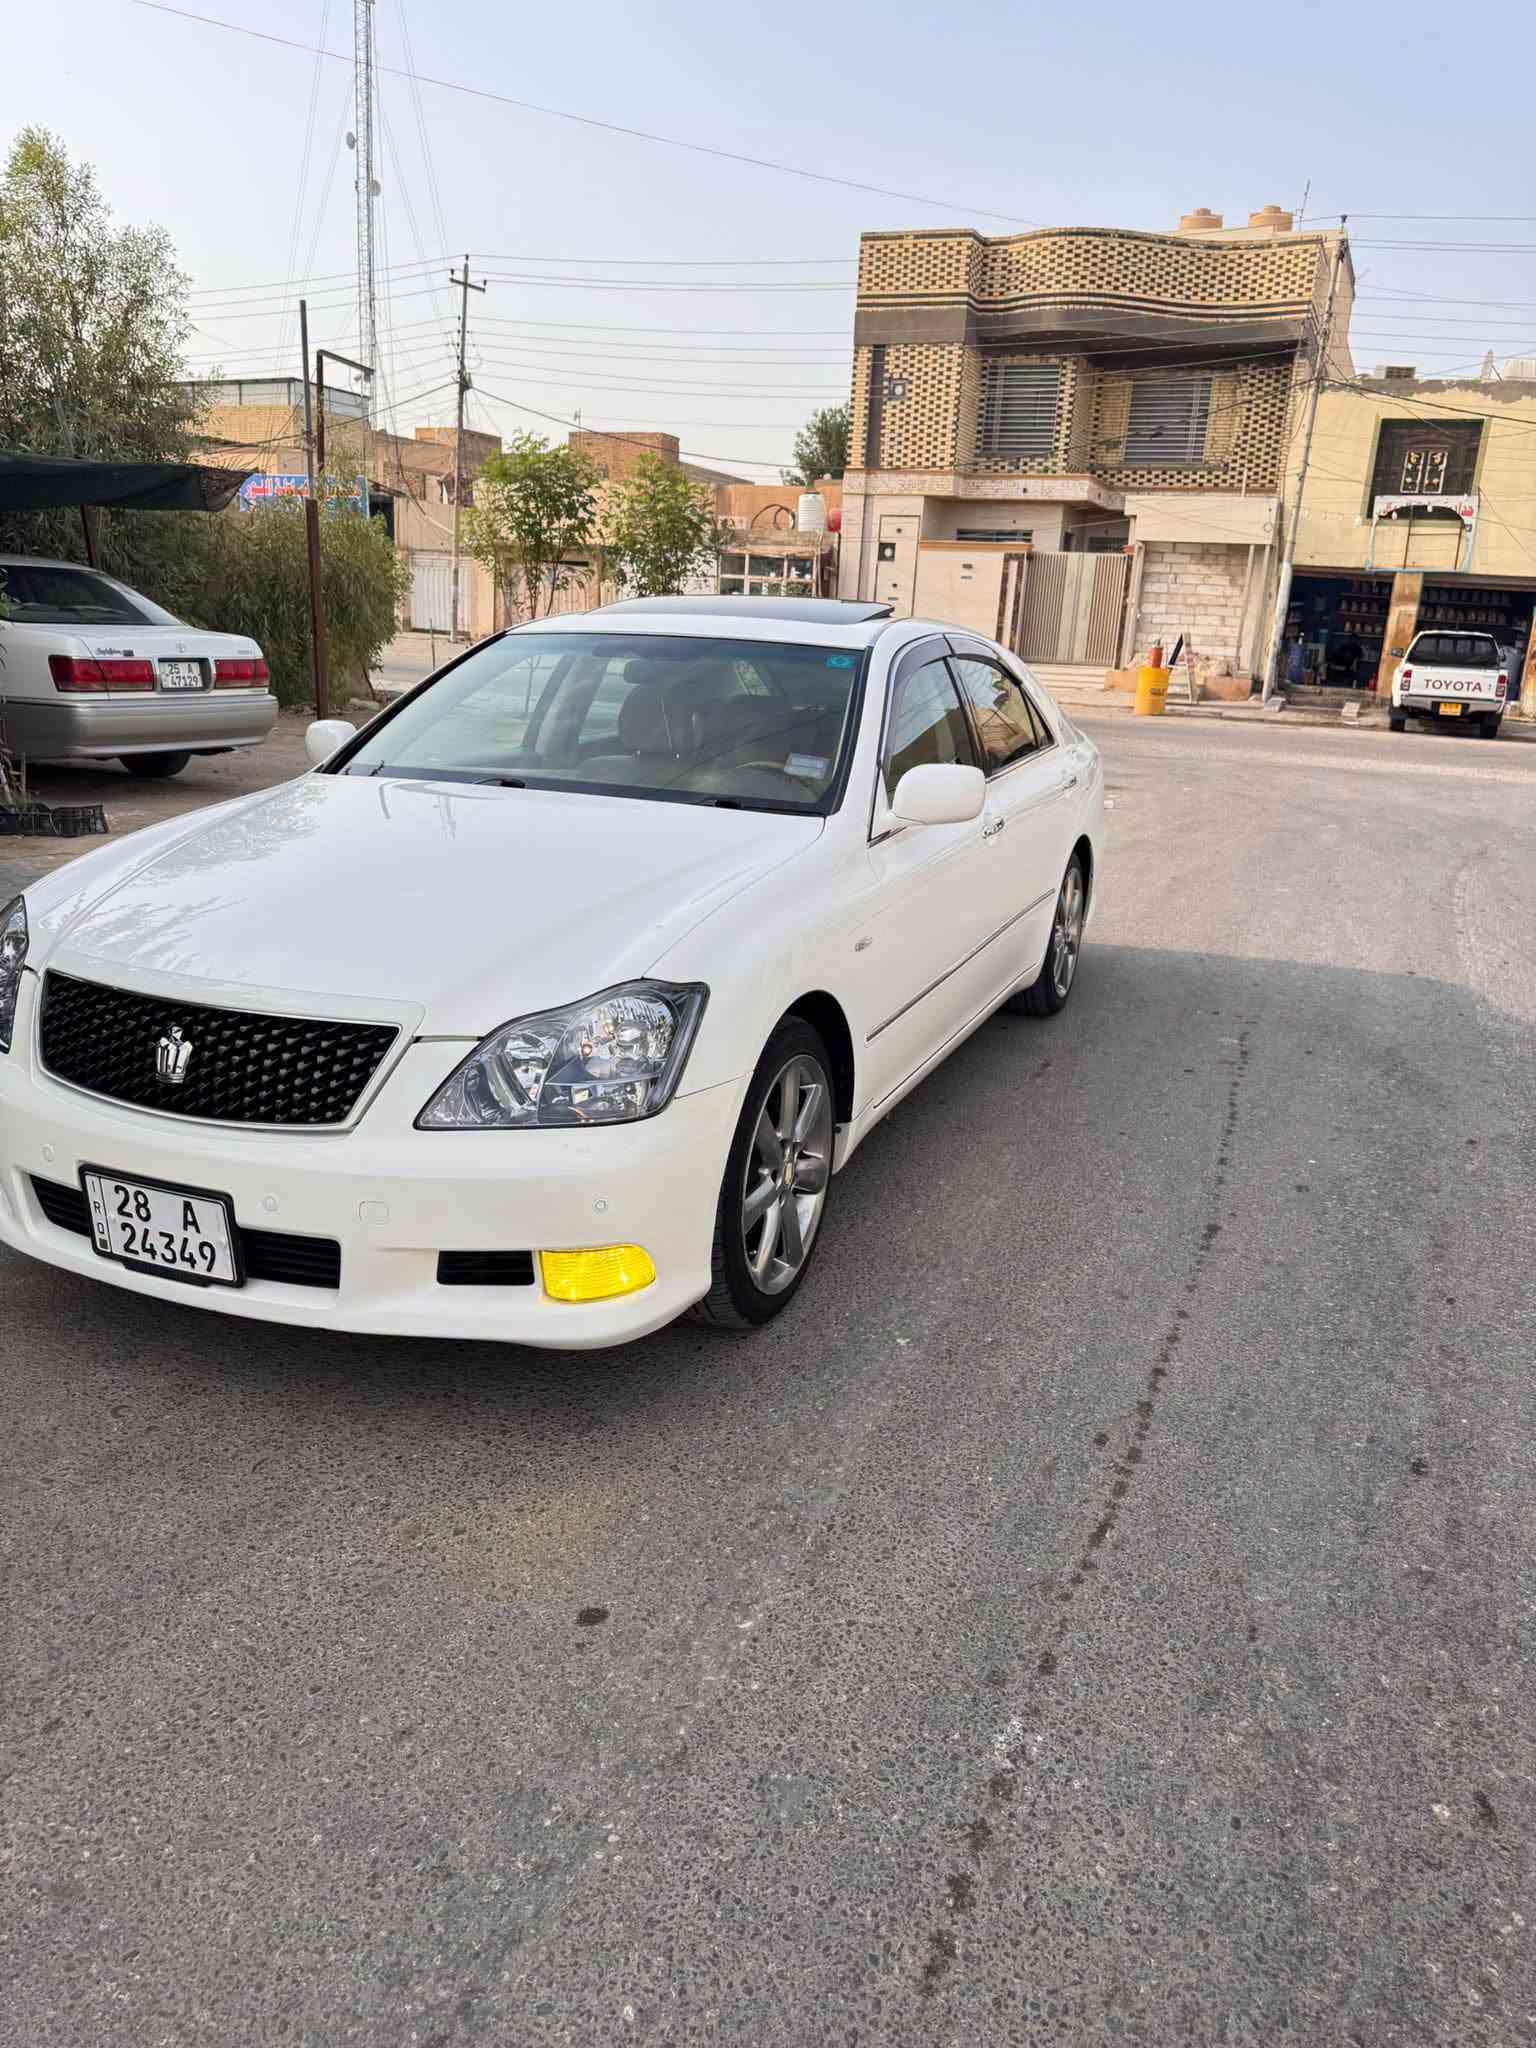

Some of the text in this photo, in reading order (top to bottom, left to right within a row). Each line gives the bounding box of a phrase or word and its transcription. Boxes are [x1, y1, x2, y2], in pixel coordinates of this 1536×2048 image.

[168, 663, 180, 675] 25
[1424, 678, 1482, 693] TOYOTA
[114, 1184, 201, 1234] 28 A
[120, 1222, 217, 1273] 24349
